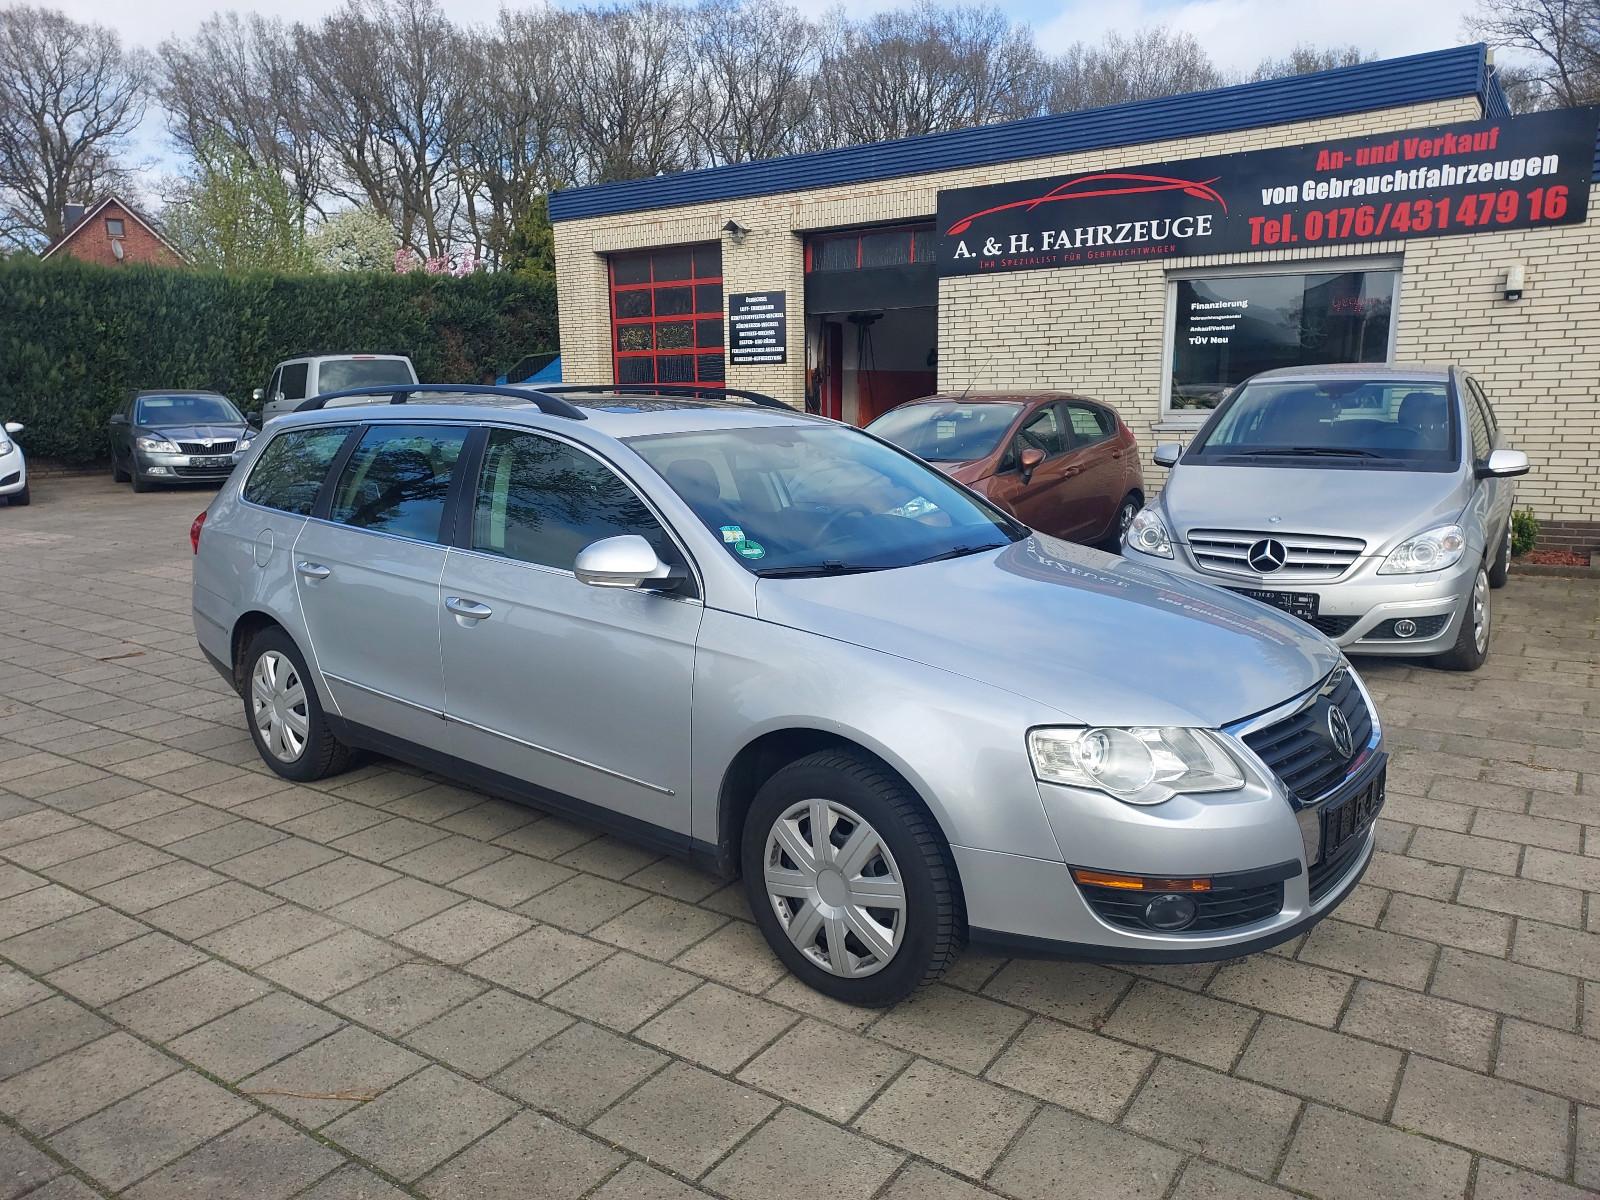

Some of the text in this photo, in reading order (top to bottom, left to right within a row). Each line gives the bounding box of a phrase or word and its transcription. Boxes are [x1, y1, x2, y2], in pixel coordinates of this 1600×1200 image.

[1316, 127, 1499, 171] An- und Verkauf
[1262, 154, 1559, 206] von Gebrauchtfahrzeugen
[953, 214, 1213, 259] A. & H. FAHRZEUGE
[1249, 213, 1298, 246] Tel.
[1529, 185, 1569, 220] 16
[1191, 299, 1248, 310] Finanzierung
[1189, 336, 1229, 345] TÜV Neu
